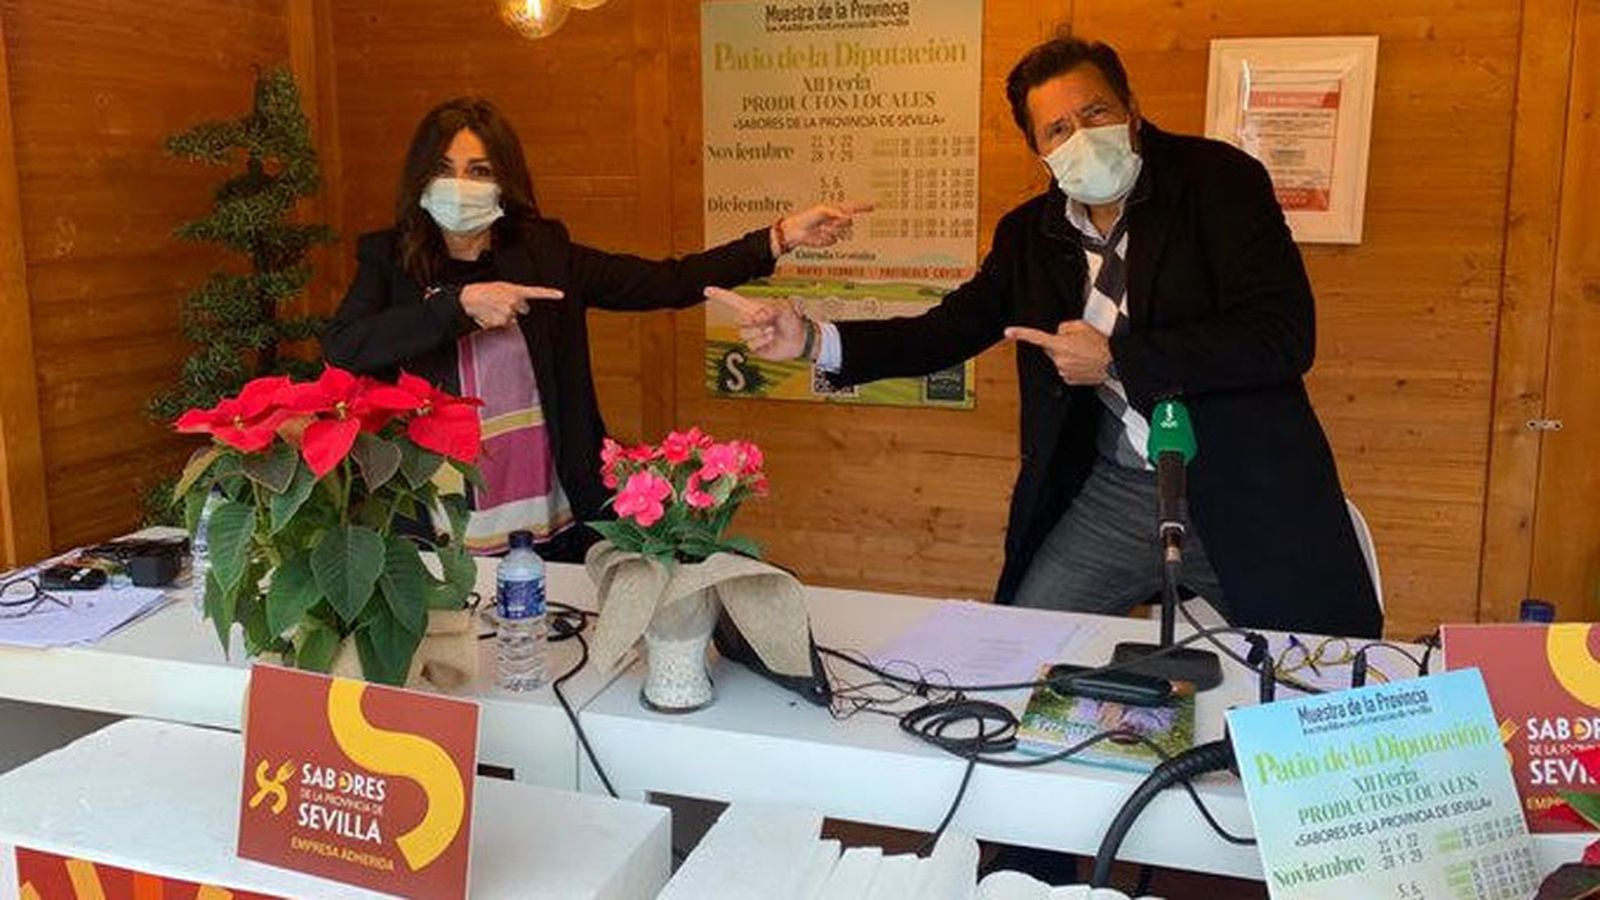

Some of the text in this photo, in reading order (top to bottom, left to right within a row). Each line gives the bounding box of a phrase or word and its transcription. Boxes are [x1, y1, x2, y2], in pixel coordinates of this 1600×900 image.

[765, 0, 910, 23] Muestra de la Provincia
[714, 37, 967, 71] Patio de la Diputación
[801, 73, 871, 93] XII Feria
[742, 90, 936, 112] PRODUCTOS LOCALES
[787, 116, 800, 130] DE
[802, 116, 817, 129] LA
[819, 114, 879, 129] PROVINCIA
[881, 114, 897, 128] DE
[707, 141, 794, 161] Noviembre
[707, 195, 793, 213] Diciembre
[725, 351, 745, 392] S
[1298, 701, 1346, 725] Muestra
[1347, 696, 1363, 716] de
[1363, 694, 1376, 713] la
[1376, 688, 1430, 711] Provincia
[1254, 723, 1490, 786] Patio de la Diputación
[1528, 743, 1542, 756] DE
[1543, 743, 1558, 756] LA
[301, 762, 387, 801] SABORES
[1376, 765, 1420, 791] Feria
[1529, 758, 1597, 785] SEVI
[300, 787, 384, 816] DE LA PROVINCIA DE
[1298, 775, 1479, 826] PRODUCTOS LOCALES
[297, 802, 382, 845] SEVILLA
[1350, 821, 1365, 837] DE
[1365, 818, 1379, 835] LA
[1380, 808, 1435, 829] PROVINCIA
[1437, 805, 1451, 820] DE
[292, 836, 395, 872] EMPRESA ADHERIDA
[1273, 855, 1365, 888] Noviembre
